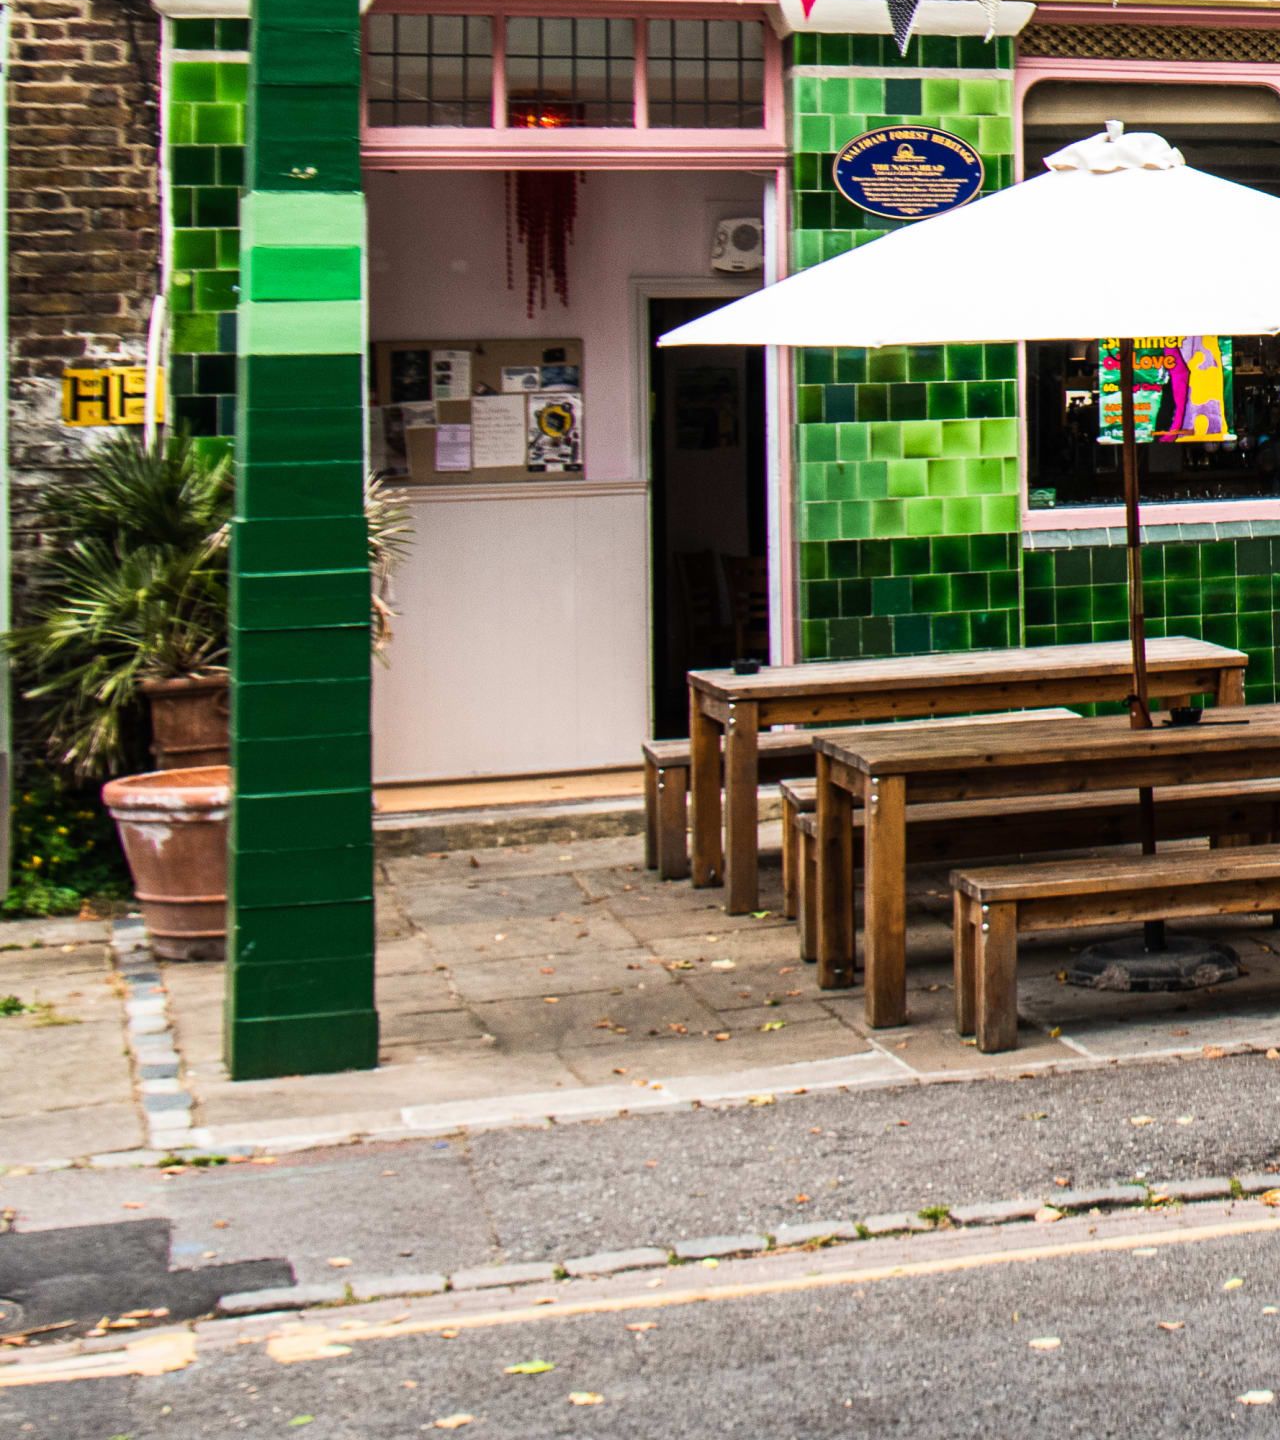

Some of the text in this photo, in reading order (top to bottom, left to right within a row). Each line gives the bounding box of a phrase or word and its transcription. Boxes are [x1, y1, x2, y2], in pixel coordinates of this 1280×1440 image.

[841, 130, 976, 166] WALTHAM FOREST HERITAGE
[872, 164, 889, 172] THE
[919, 165, 945, 173] HEAD
[1132, 353, 1176, 369] Love
[1103, 383, 1119, 392] 60s
[71, 376, 109, 420] H
